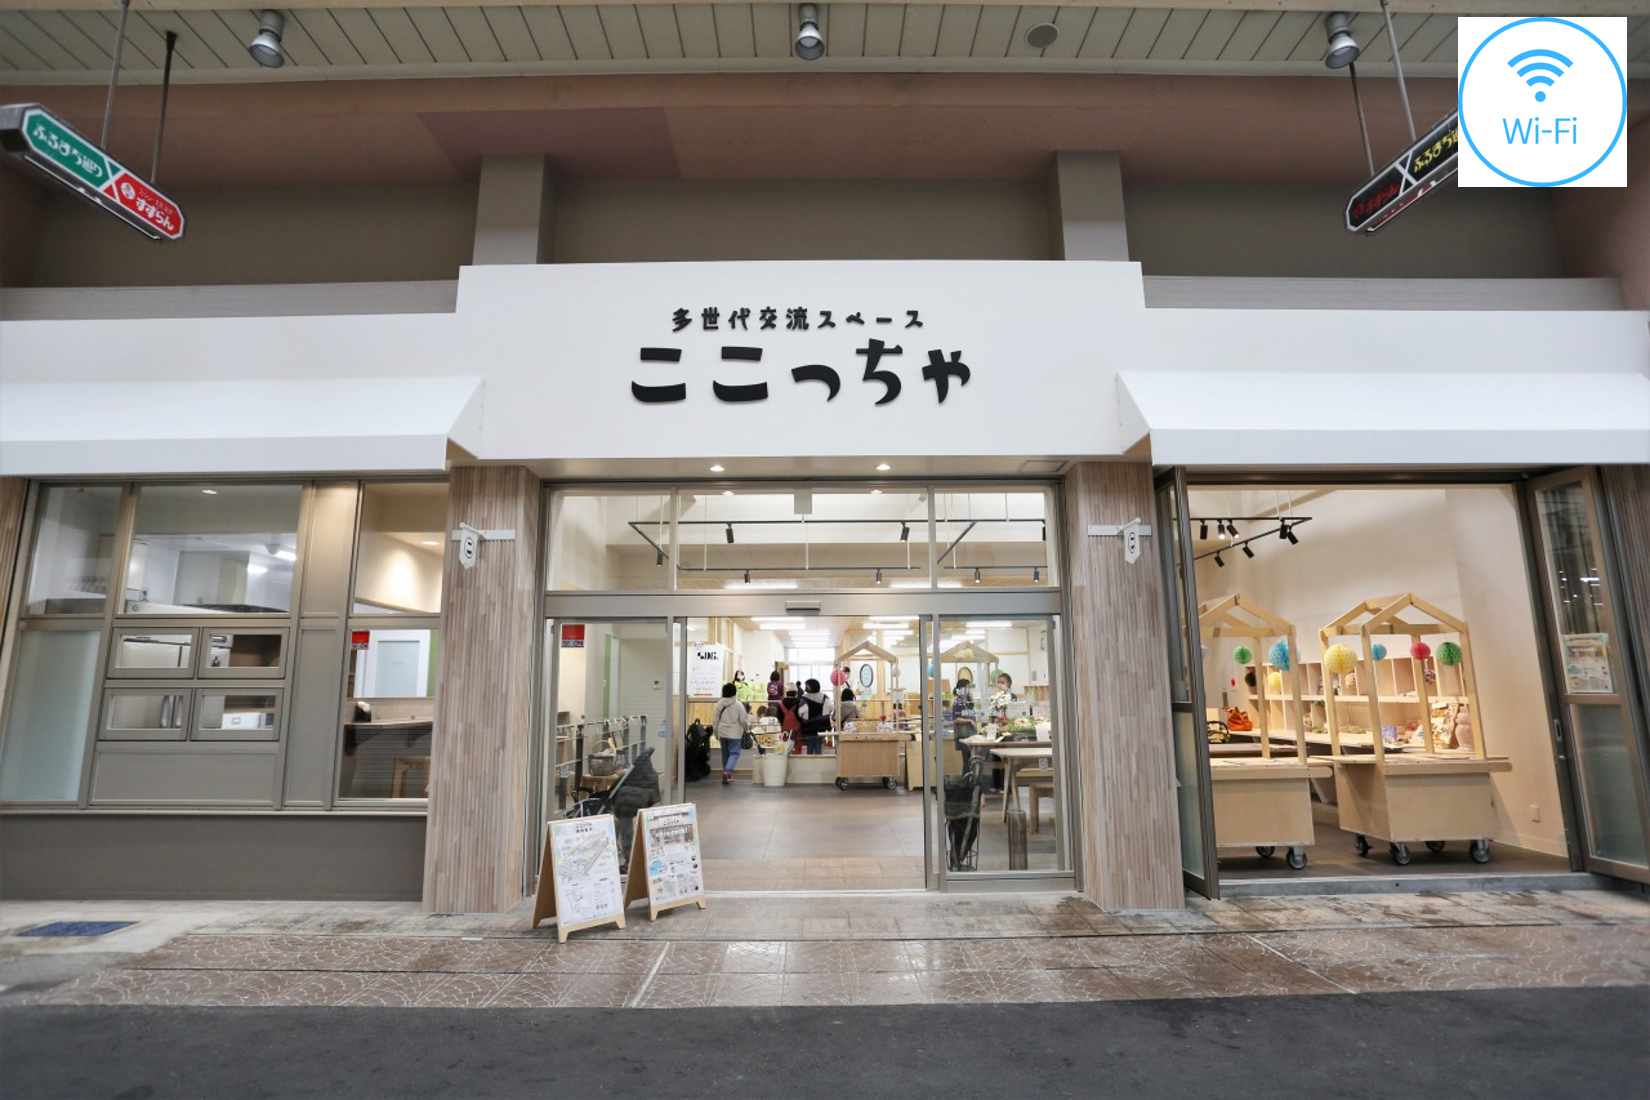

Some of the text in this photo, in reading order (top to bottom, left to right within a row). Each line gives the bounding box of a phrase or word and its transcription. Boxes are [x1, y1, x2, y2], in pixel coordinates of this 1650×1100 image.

[136, 197, 175, 231] すずらん
[672, 306, 924, 333] 多世代交流スペース
[631, 338, 972, 406] ここっちゃ
